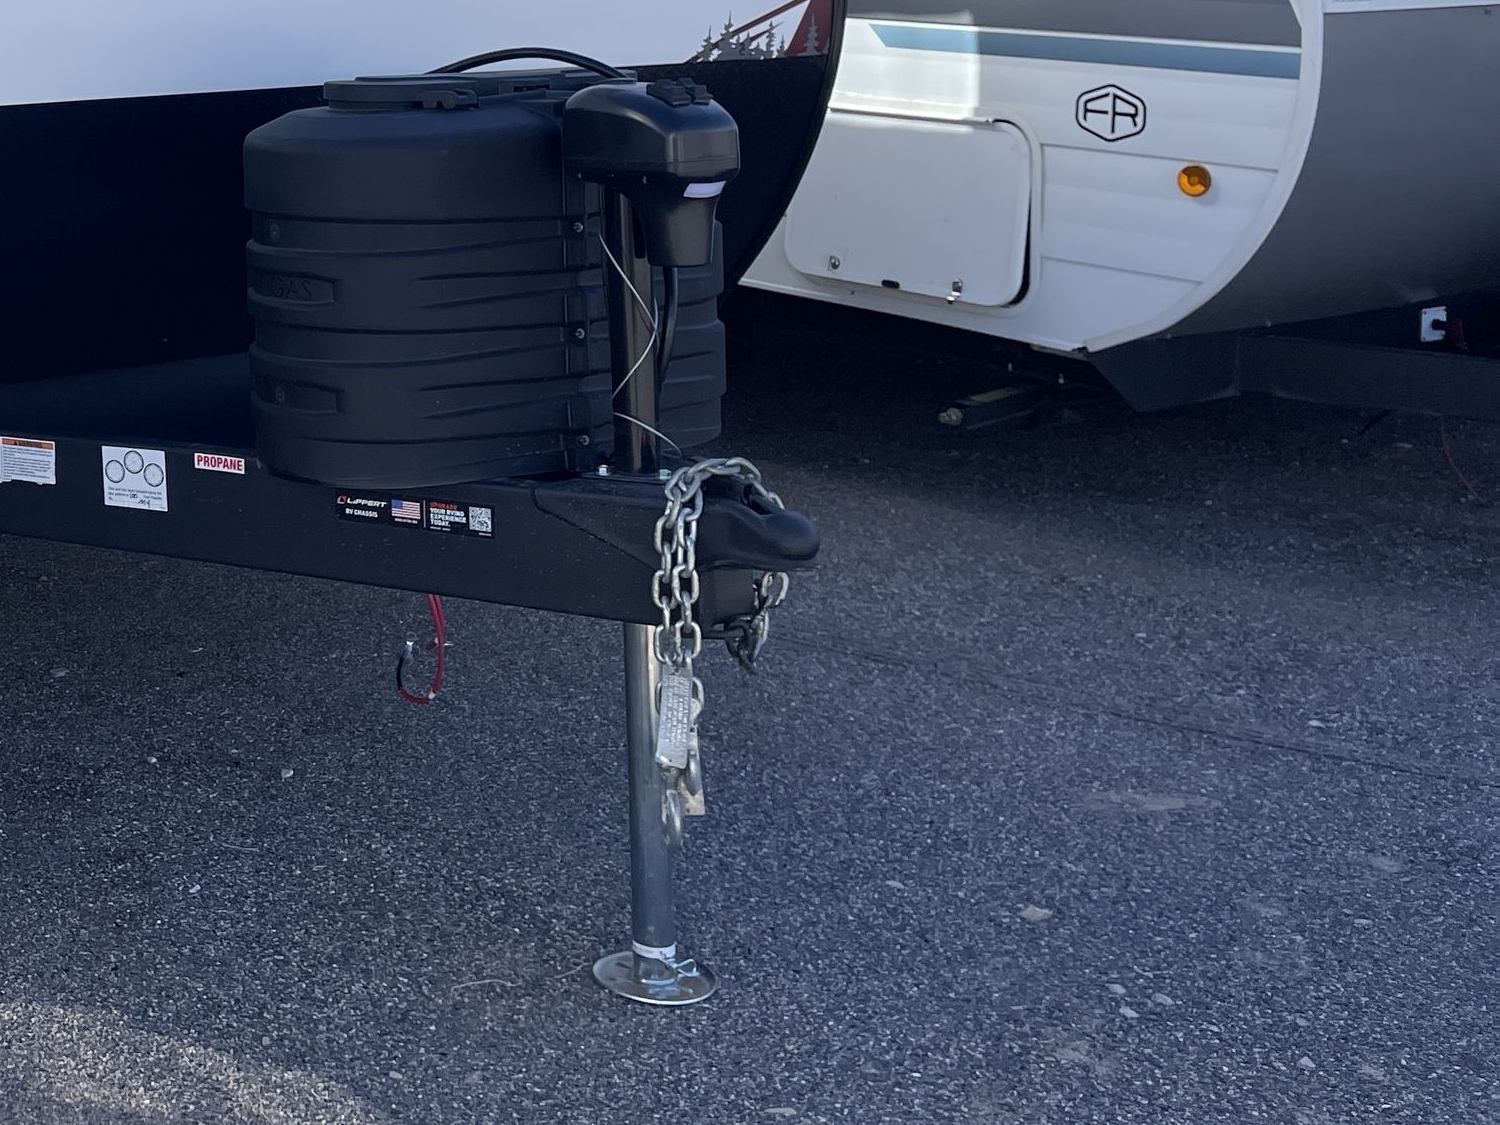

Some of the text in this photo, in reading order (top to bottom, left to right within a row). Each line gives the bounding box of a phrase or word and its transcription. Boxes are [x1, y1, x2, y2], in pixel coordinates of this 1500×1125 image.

[270, 275, 313, 301] GAS
[196, 454, 244, 472] PROPANE
[345, 507, 379, 518] RV CHASSIS
[430, 507, 446, 515] YOUR
[430, 513, 467, 524] EXPERIENCE
